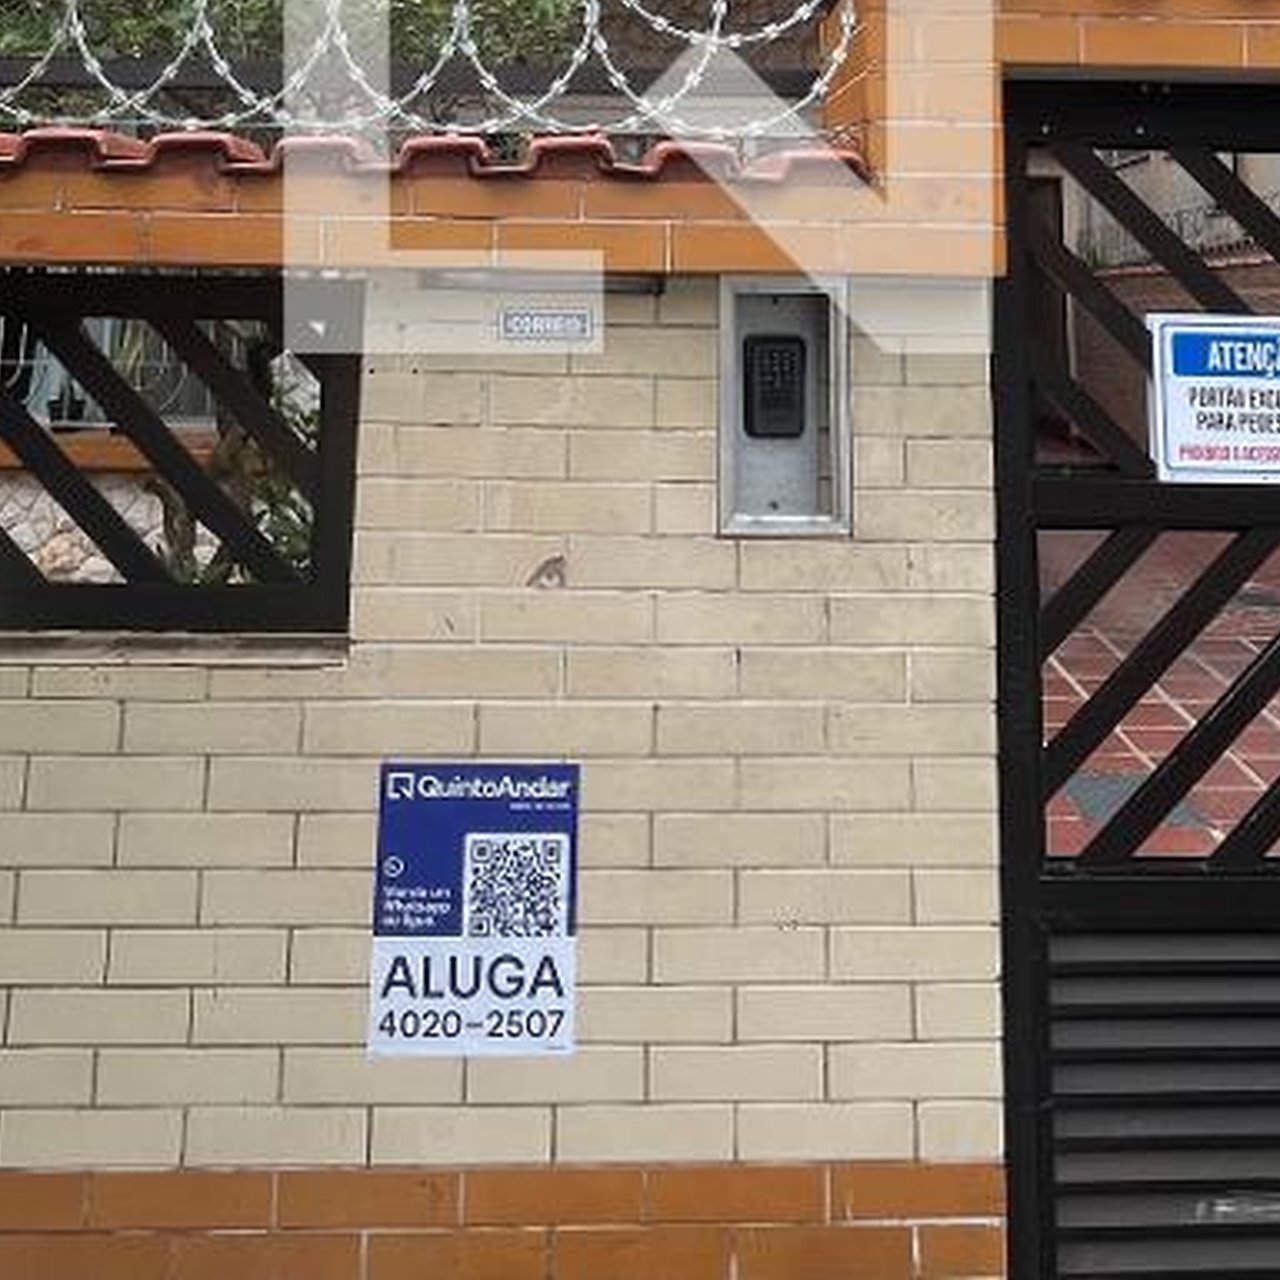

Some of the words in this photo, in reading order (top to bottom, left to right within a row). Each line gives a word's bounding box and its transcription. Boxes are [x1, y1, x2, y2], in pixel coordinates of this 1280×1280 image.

[1189, 385, 1245, 408] PORTÃO
[1196, 411, 1236, 431] PARA
[417, 775, 571, 799] QuintoAndar
[381, 954, 565, 999] ALUGA
[378, 1009, 566, 1038] 4020-2507
